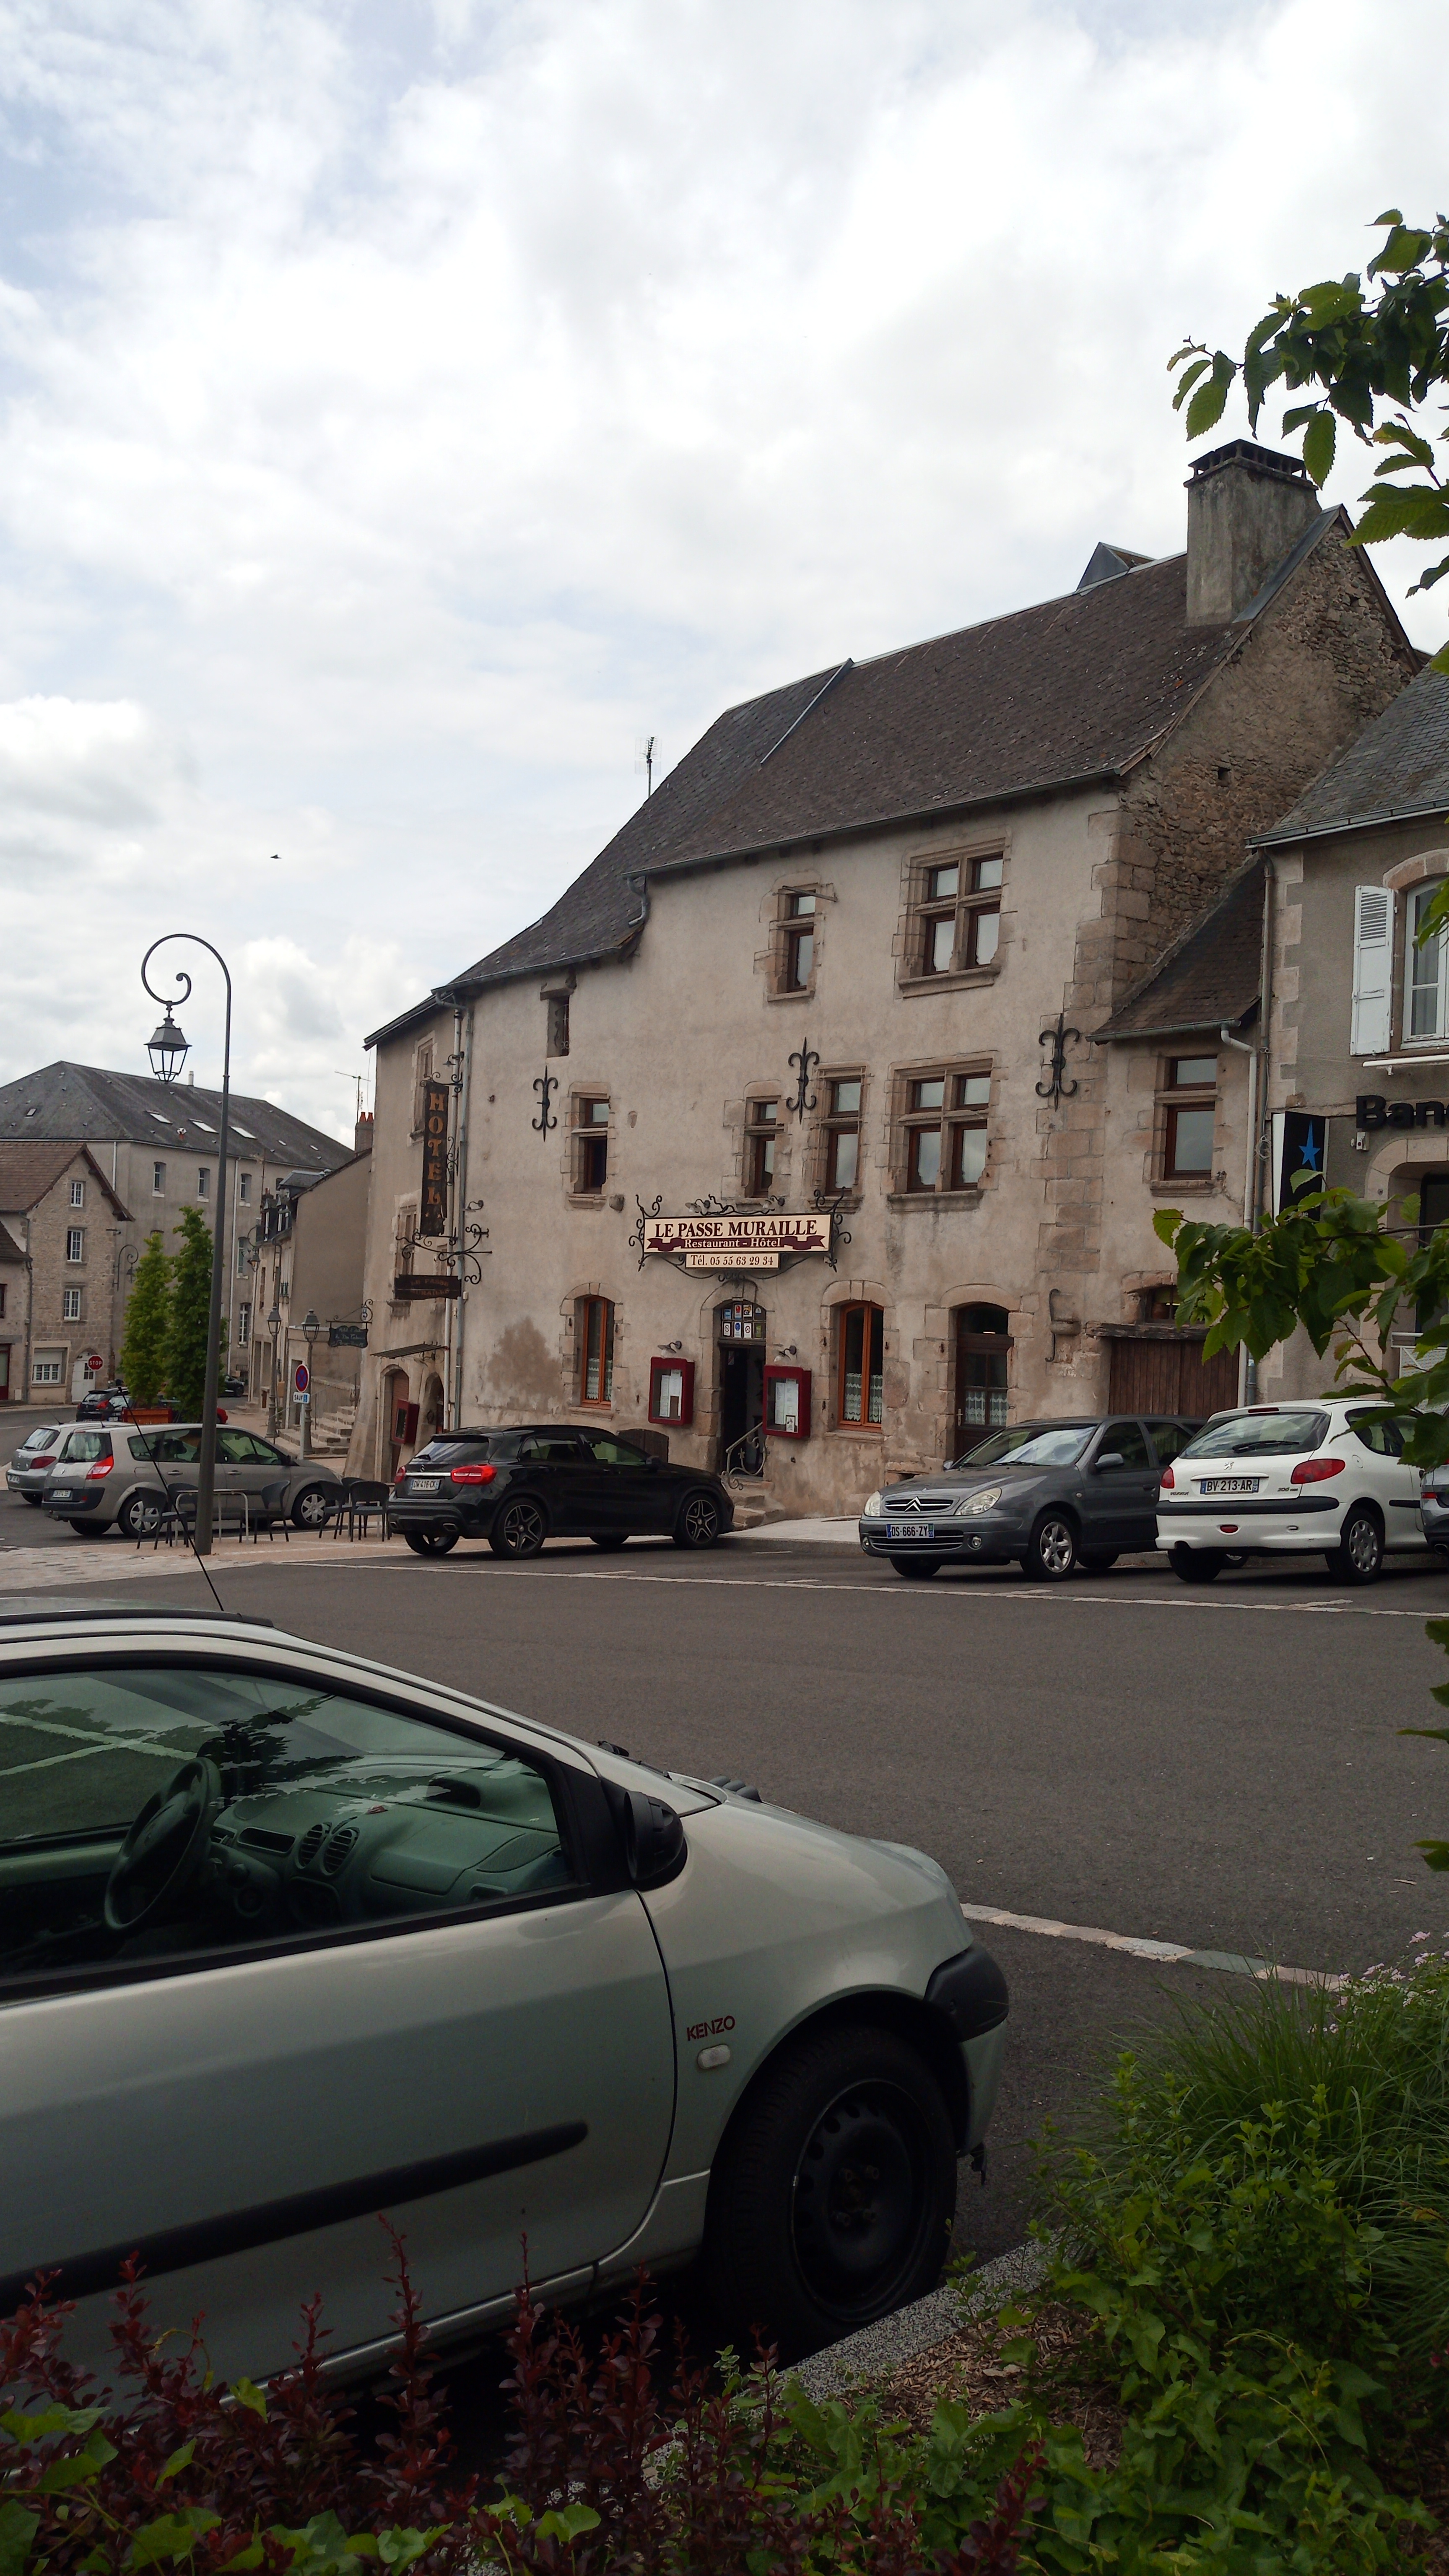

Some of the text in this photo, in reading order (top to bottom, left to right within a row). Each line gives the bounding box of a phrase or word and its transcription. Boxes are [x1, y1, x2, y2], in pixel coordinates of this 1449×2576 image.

[1356, 1095, 1449, 1129] Ban
[427, 1093, 445, 1205] HOTEL
[655, 1220, 818, 1238] LE PASSE MURAILLE
[684, 1238, 740, 1249] Restaurant
[749, 1237, 781, 1247] Hôtel
[691, 1254, 774, 1266] Tél. 05 55 63 29 34
[1207, 1480, 1252, 1491] BV-213-AR
[891, 1526, 928, 1537] DS-666-ZY
[686, 2015, 735, 2041] KENZO
